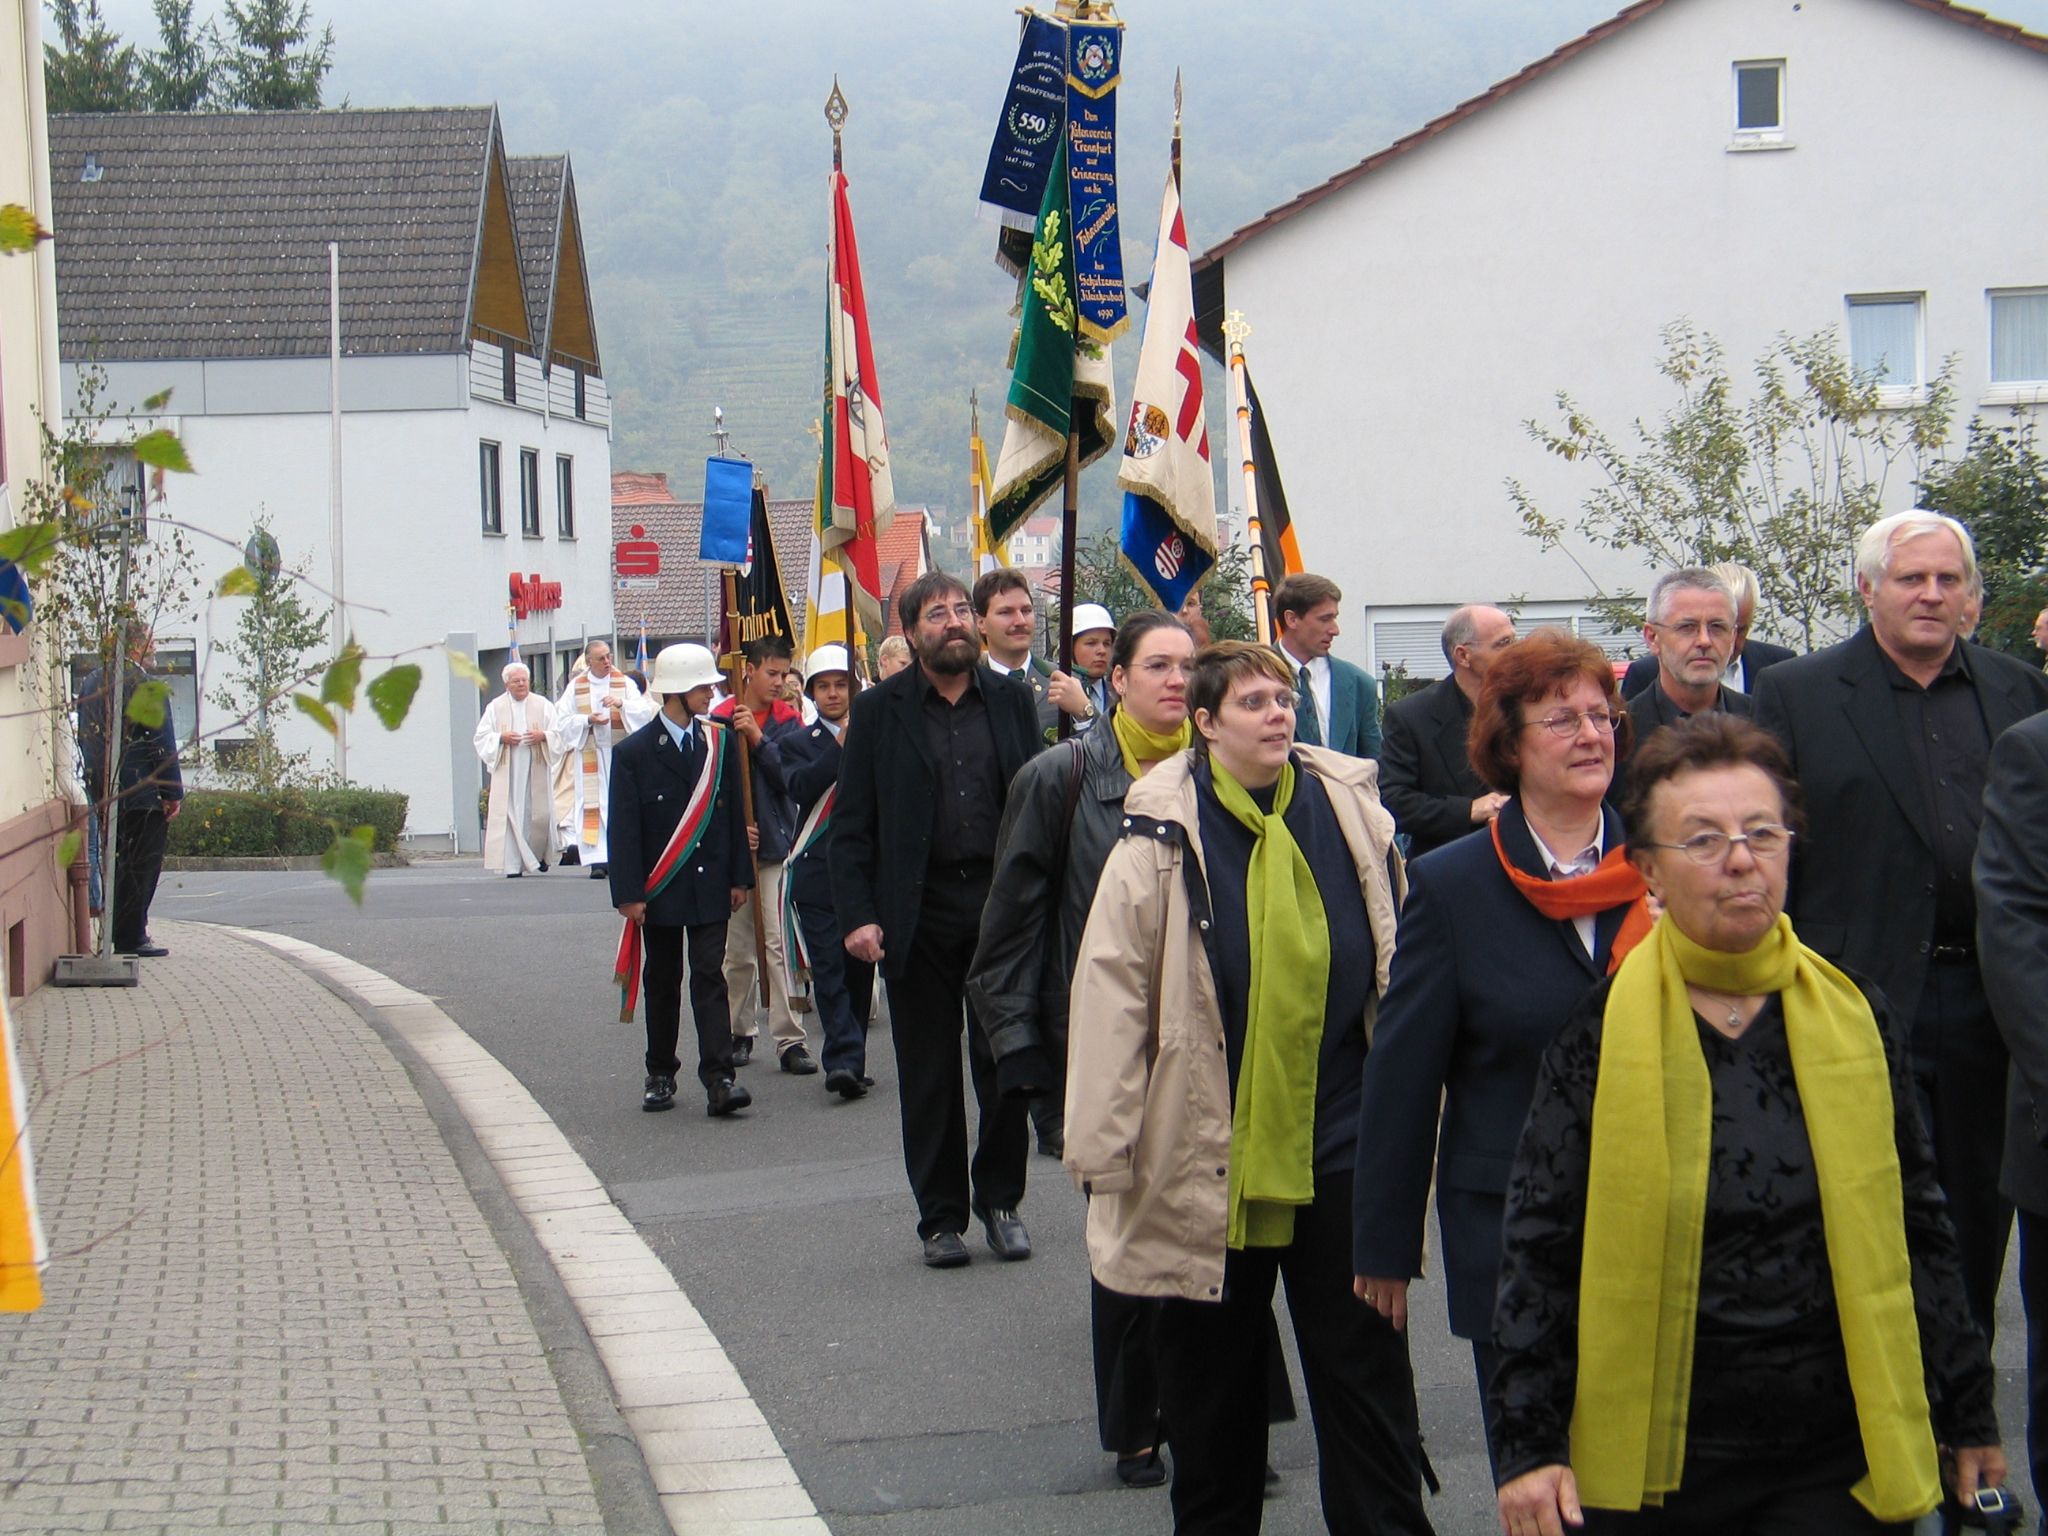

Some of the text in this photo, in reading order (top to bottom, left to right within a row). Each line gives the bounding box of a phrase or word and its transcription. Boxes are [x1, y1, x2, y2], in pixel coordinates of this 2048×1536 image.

[1018, 112, 1046, 133] 550
[1071, 167, 1114, 186] Erinnerung
[1097, 308, 1114, 321] 1990
[509, 572, 562, 620] Sparkasse
